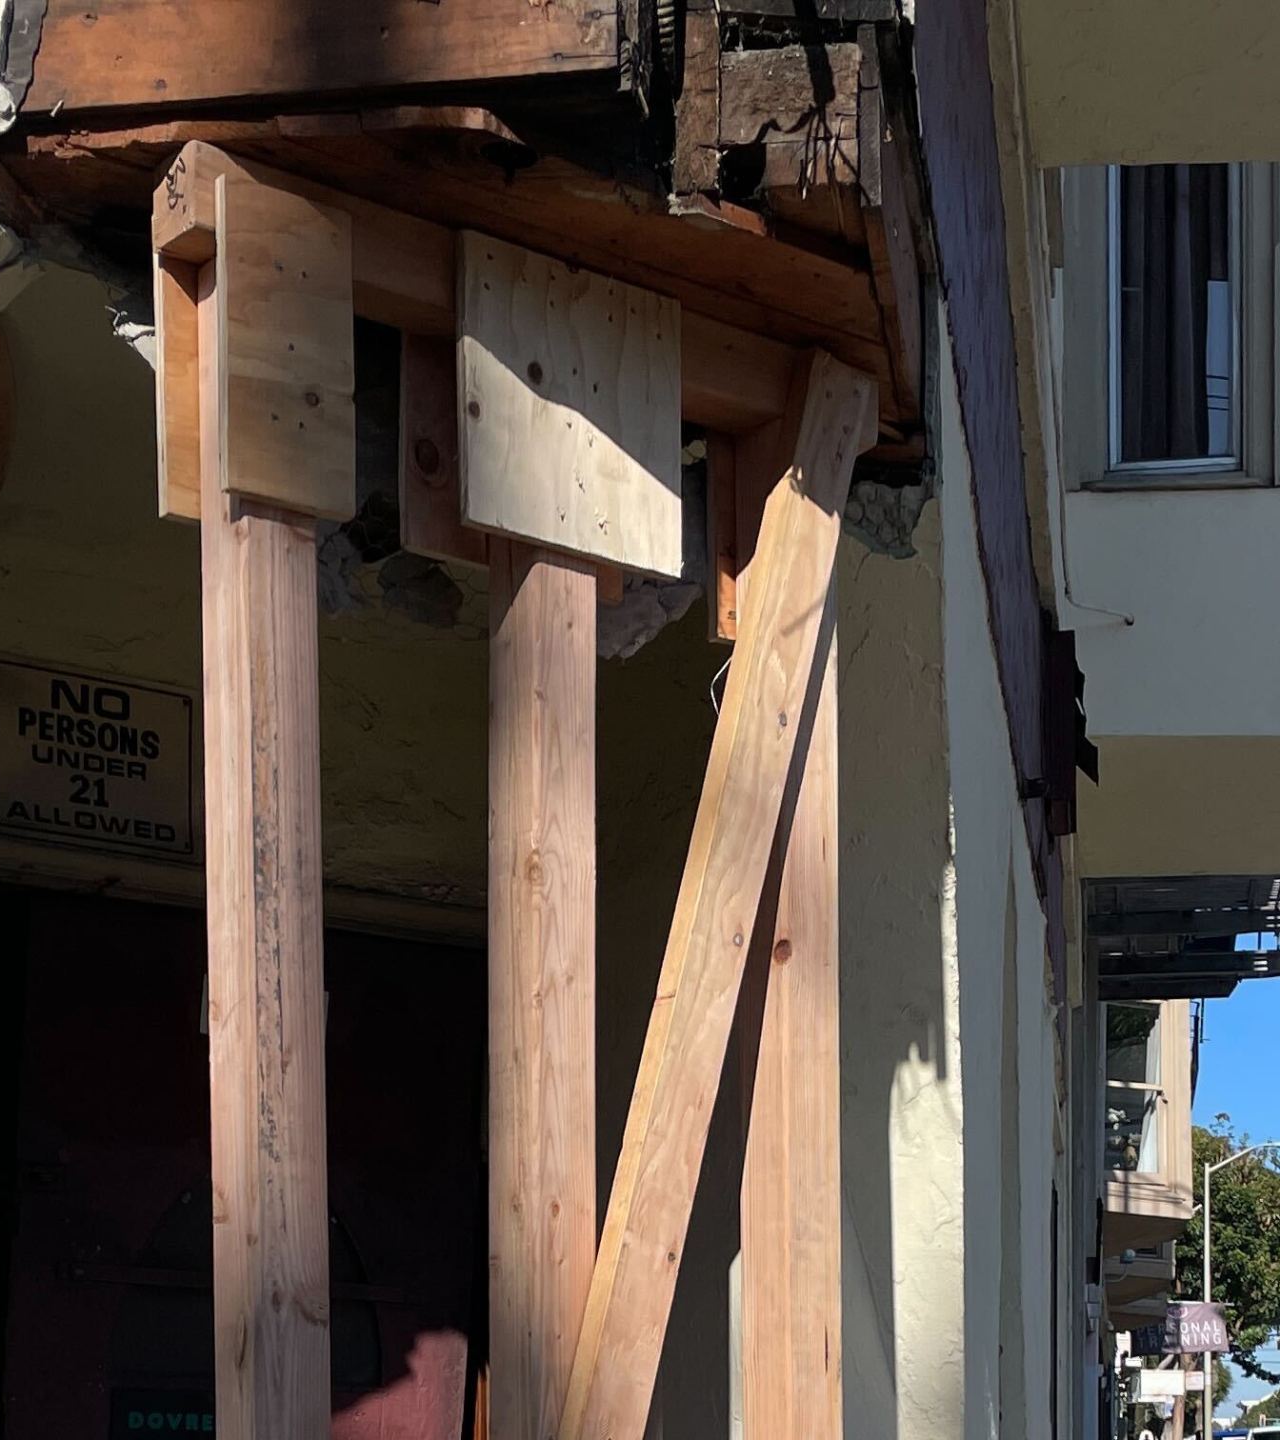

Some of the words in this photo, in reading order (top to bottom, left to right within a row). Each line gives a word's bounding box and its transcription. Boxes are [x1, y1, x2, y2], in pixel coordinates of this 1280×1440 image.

[51, 679, 130, 720] NO
[18, 707, 160, 759] PERSONS
[32, 745, 147, 781] UNDER
[70, 775, 109, 808] 21
[7, 801, 176, 842] ALLOWED
[128, 1411, 214, 1431] DOVRE
